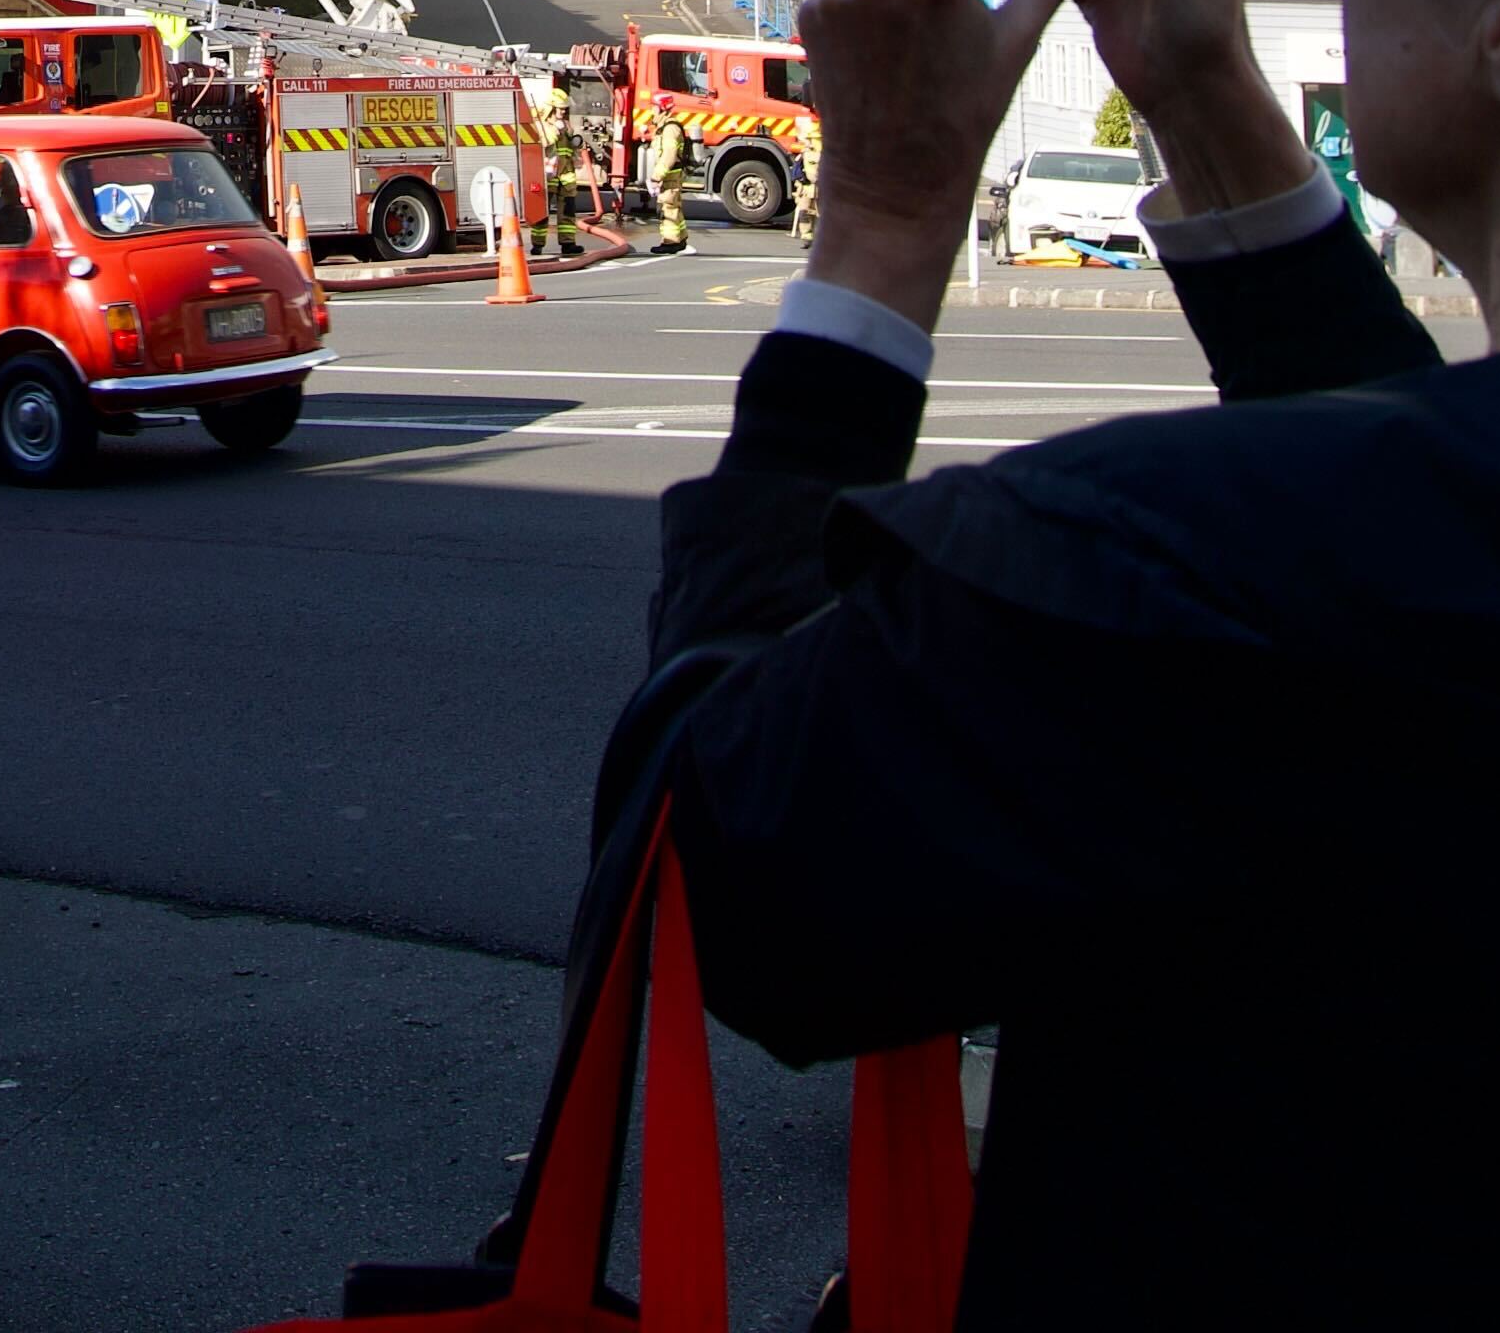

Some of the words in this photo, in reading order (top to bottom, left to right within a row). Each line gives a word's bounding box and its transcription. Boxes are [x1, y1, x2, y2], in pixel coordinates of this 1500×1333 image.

[282, 81, 311, 92] CALL
[312, 80, 328, 91] 111
[388, 78, 411, 90] FIRE
[413, 78, 436, 90] AND
[438, 77, 515, 89] EMERGENCY.NZ
[366, 97, 435, 121] RESCUE
